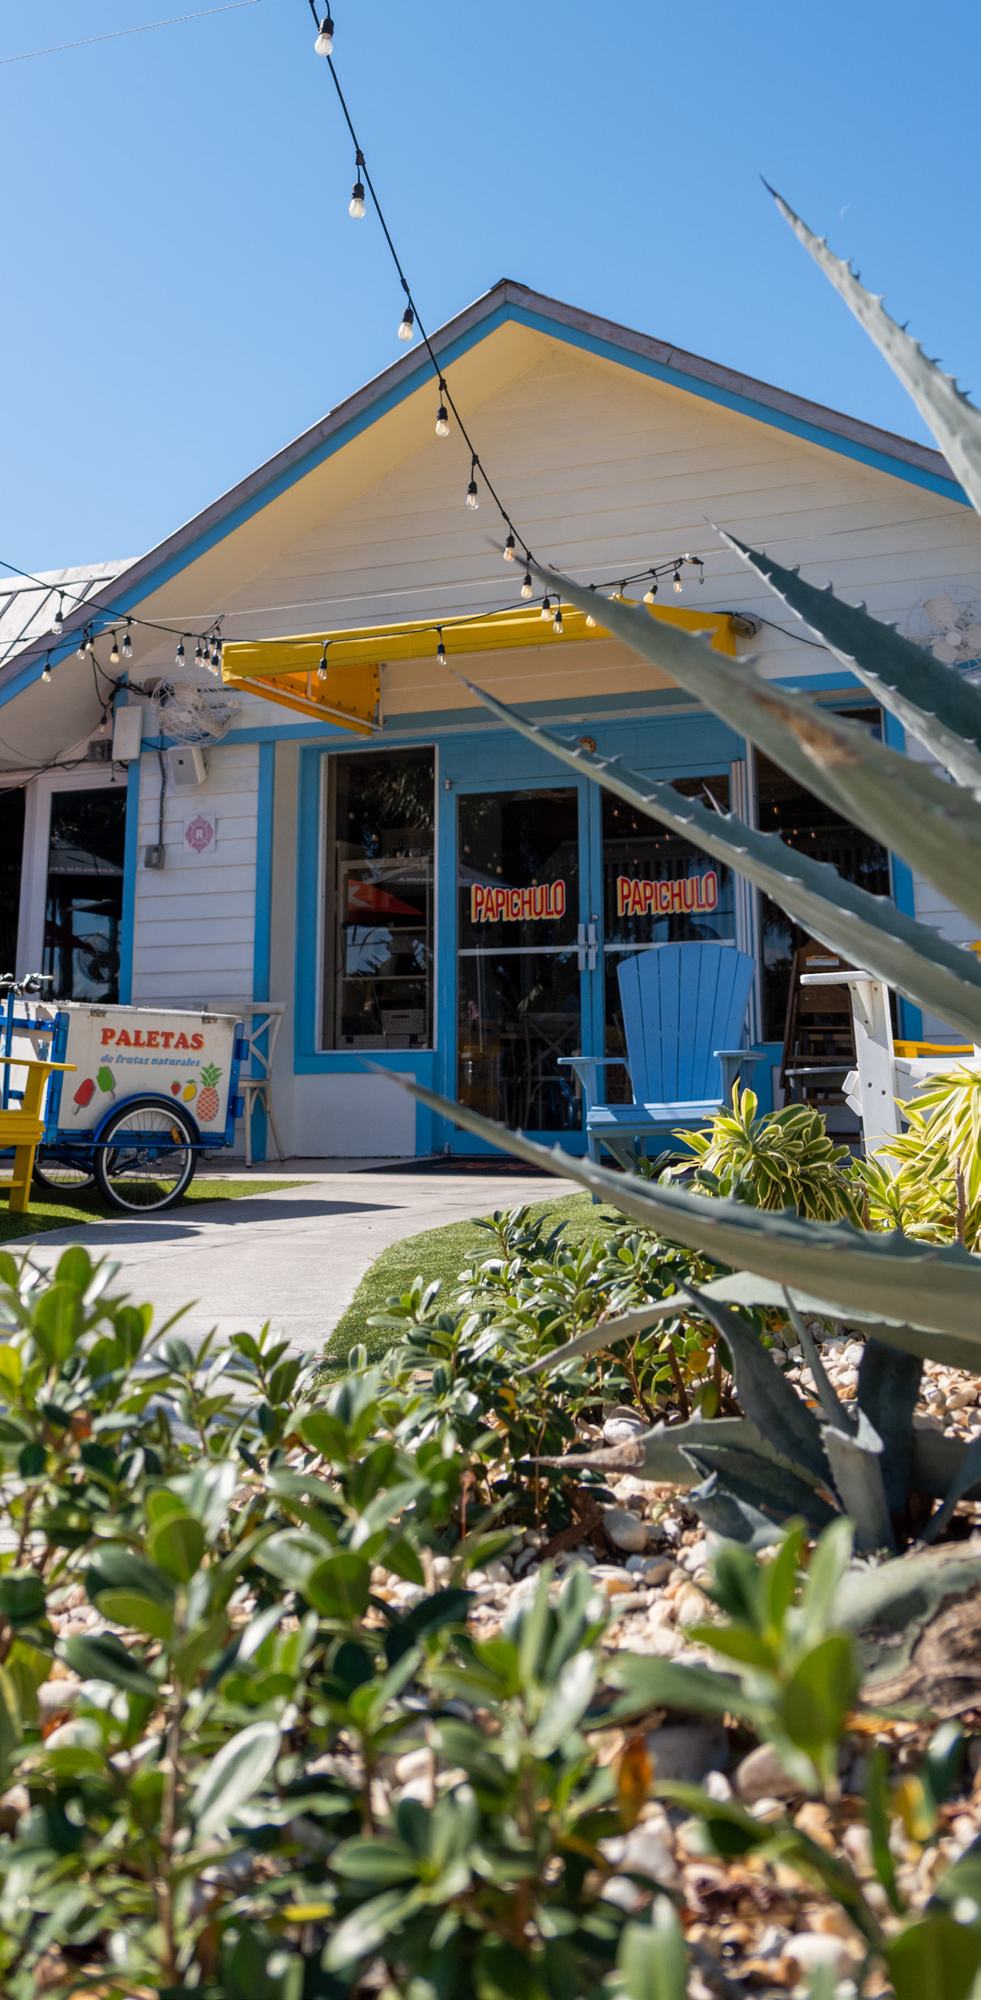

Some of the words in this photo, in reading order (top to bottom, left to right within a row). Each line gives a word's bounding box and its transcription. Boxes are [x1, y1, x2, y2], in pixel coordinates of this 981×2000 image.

[195, 828, 204, 840] R
[471, 880, 566, 923] PAPICHULO
[617, 871, 718, 916] PAPICHULO
[100, 1028, 205, 1051] PALETAS
[100, 1054, 114, 1064] de
[115, 1054, 150, 1065] frutas
[151, 1056, 201, 1067] naturales
